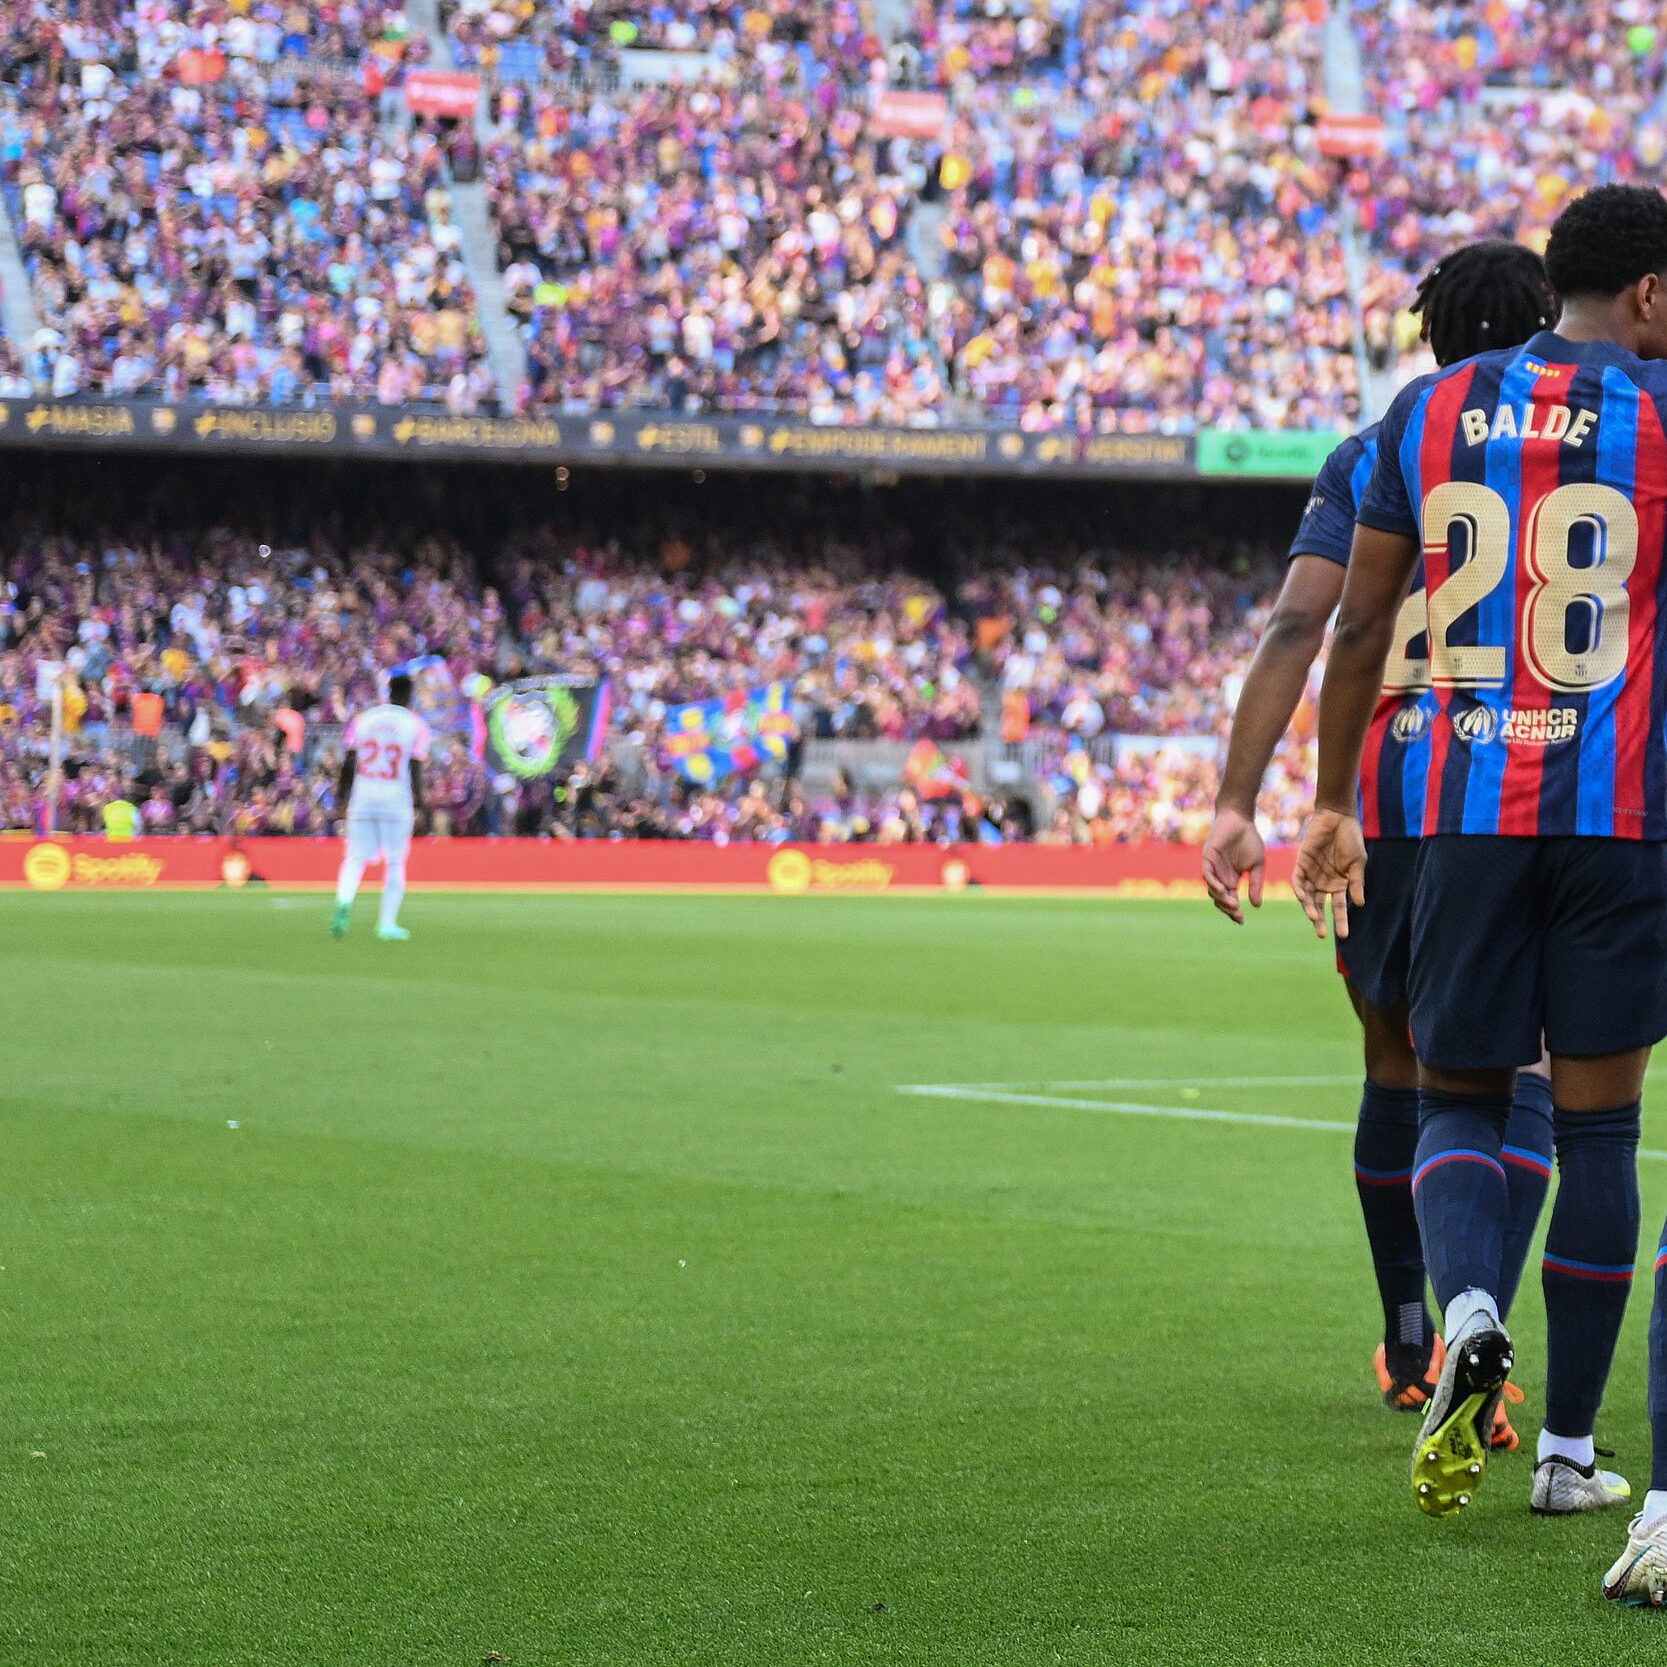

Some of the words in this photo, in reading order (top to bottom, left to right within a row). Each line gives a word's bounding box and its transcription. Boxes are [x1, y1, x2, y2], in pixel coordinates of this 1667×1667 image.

[1461, 403, 1598, 447] BALDE
[1421, 481, 1639, 693] 28
[1501, 722, 1576, 740] ACNUR
[1502, 708, 1578, 726] UNHCR
[357, 738, 403, 780] 23
